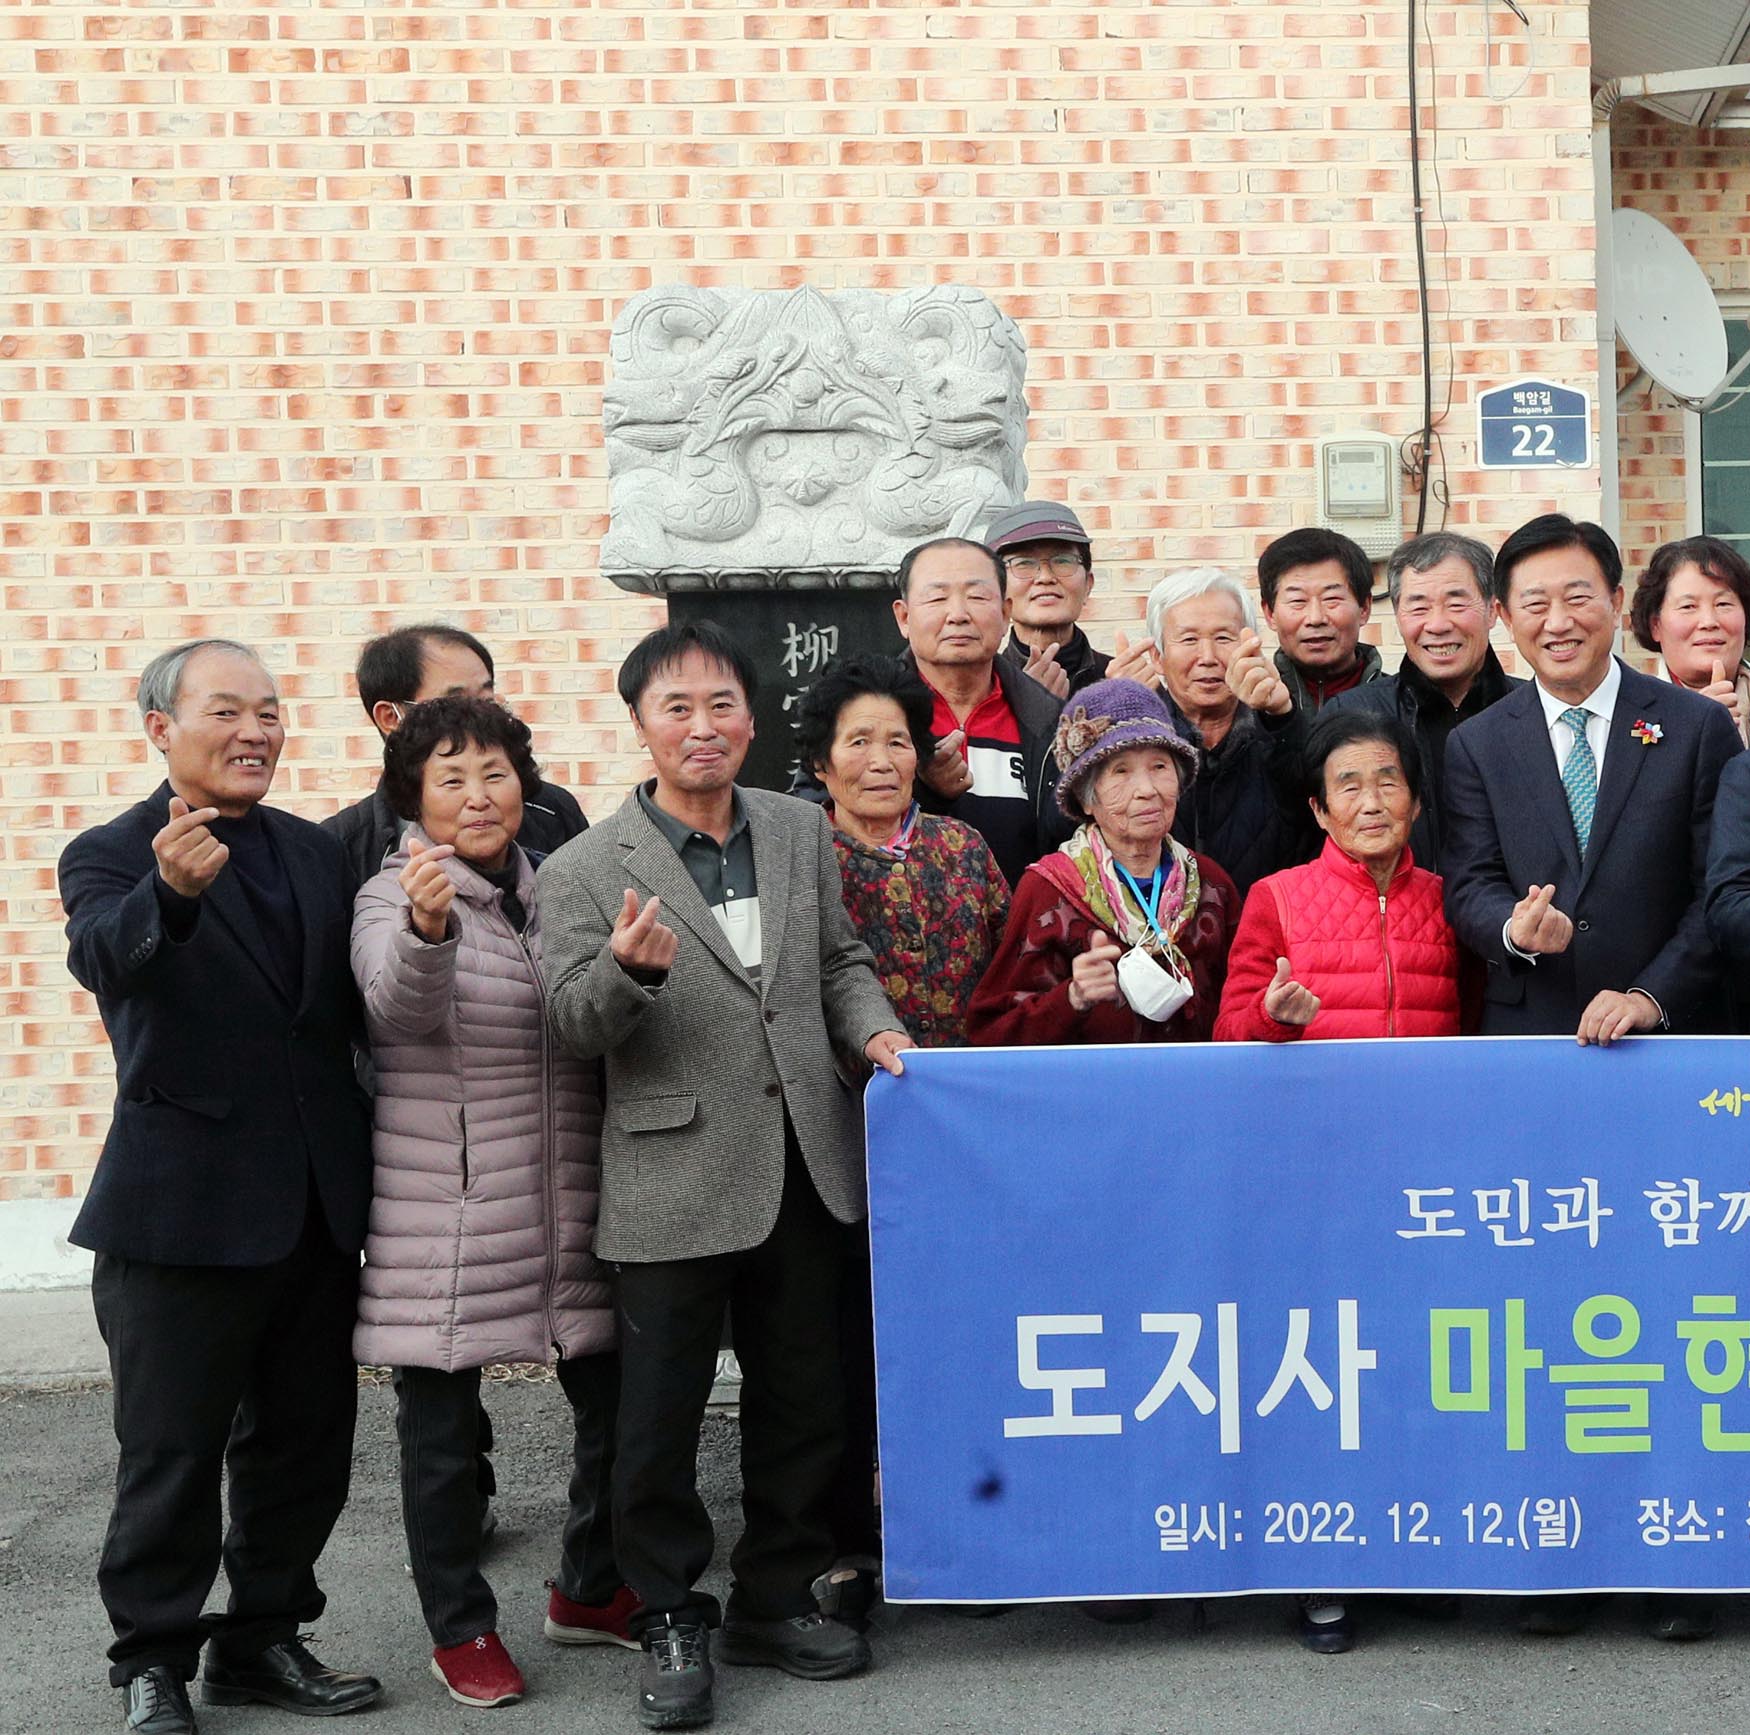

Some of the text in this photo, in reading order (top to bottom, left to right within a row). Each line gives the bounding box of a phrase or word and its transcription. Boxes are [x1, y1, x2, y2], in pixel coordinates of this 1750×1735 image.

[1512, 390, 1552, 406] 백암길
[1512, 405, 1554, 415] Baegam-gil
[1511, 424, 1556, 457] 22
[1395, 1177, 1614, 1249] 도민과
[1003, 1299, 1377, 1454] 도지사
[1154, 1502, 1243, 1552] 일시:
[1264, 1501, 1367, 1546] 2022.
[1387, 1501, 1441, 1546] 12.
[1461, 1496, 1582, 1551] 12.(월)
[1637, 1497, 1725, 1547] 장소:
